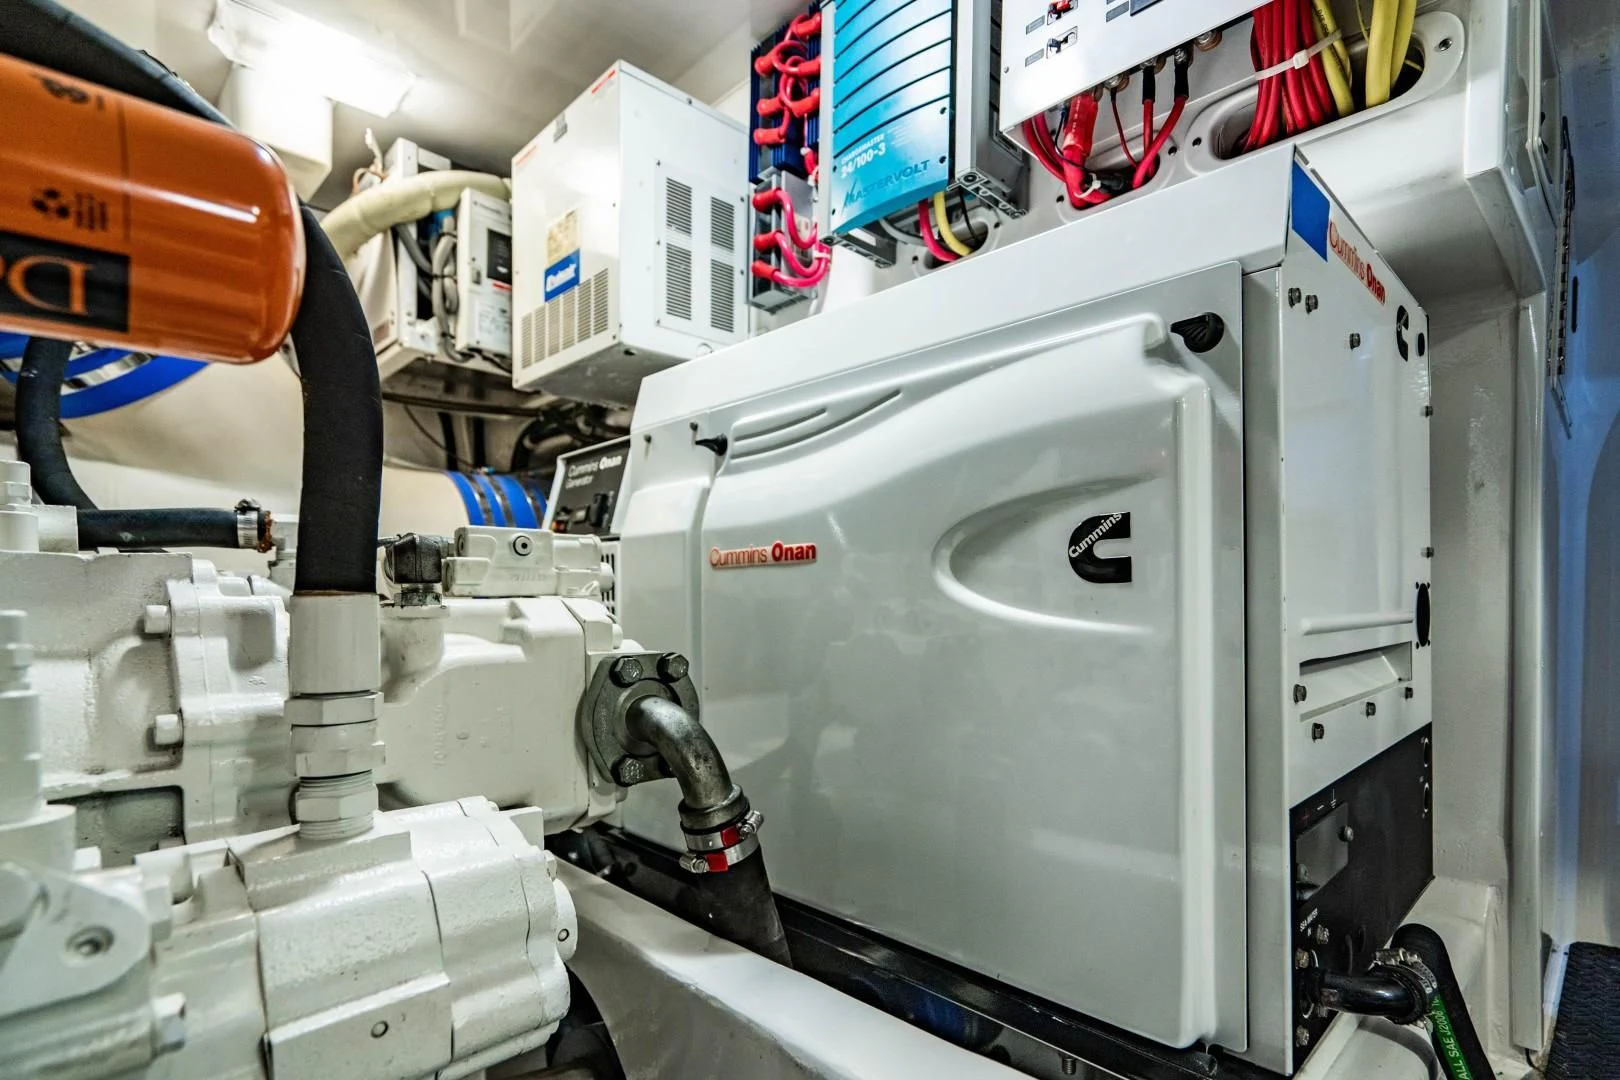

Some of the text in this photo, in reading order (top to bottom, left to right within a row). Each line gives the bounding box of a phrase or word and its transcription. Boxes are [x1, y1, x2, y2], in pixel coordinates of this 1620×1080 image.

[843, 159, 930, 208] MASTERVOLT
[1329, 220, 1386, 306] Cummins Onan
[568, 455, 622, 478] Cummins Onan
[1068, 513, 1122, 558] Cummins
[710, 542, 816, 567] Cummins Onan
[1443, 1036, 1460, 1058] SAE
